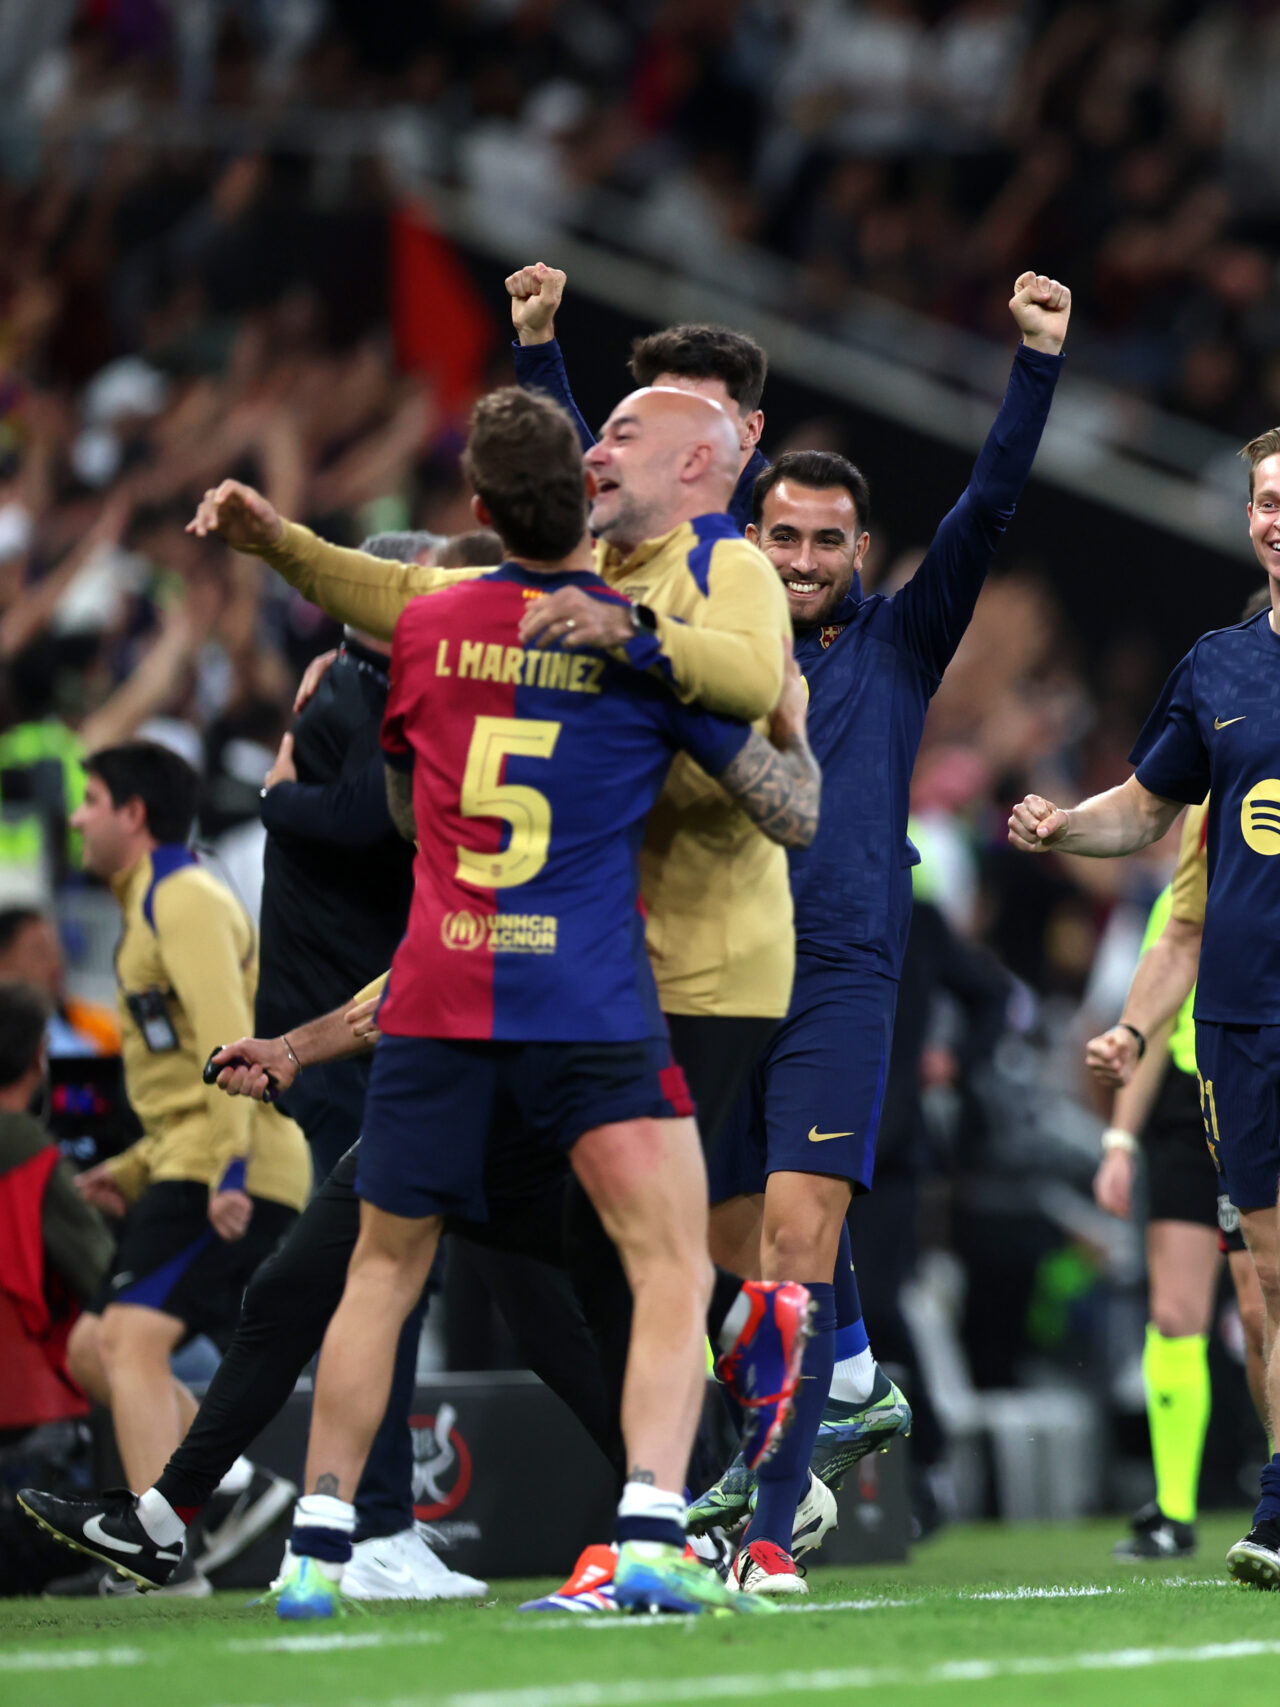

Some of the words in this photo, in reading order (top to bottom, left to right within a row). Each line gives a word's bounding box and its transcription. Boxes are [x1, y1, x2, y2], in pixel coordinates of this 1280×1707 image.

[454, 715, 562, 889] 5
[487, 914, 557, 932] UNHCR
[487, 930, 557, 947] ACNUR
